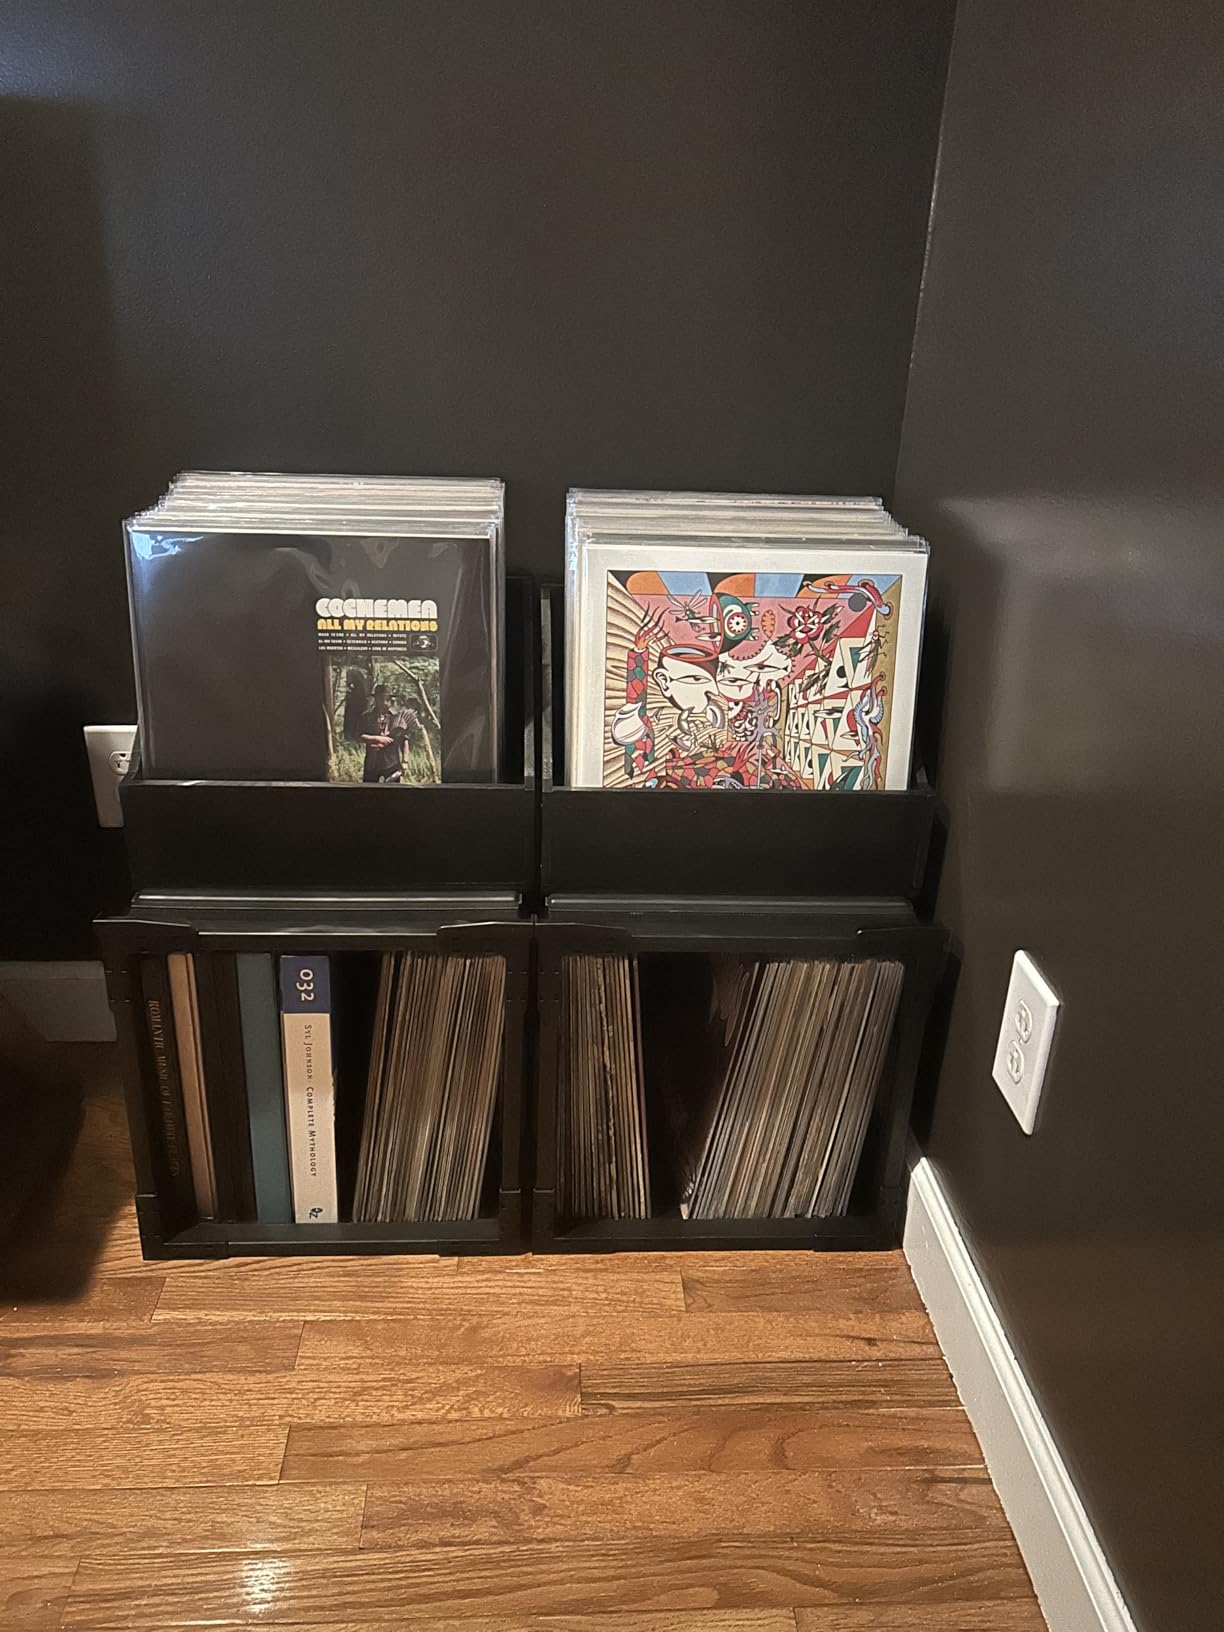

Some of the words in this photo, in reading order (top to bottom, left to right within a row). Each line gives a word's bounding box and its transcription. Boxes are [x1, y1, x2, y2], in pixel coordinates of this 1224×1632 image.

[315, 598, 437, 618] COCHEMEA
[317, 619, 341, 630] ALL
[343, 619, 364, 630] MY
[366, 620, 438, 631] RELATIONS
[296, 969, 315, 1001] 032
[304, 1024, 313, 1040] SYL
[306, 1086, 315, 1126] COMPLETE
[308, 1130, 317, 1177] MYTHOLOGY
